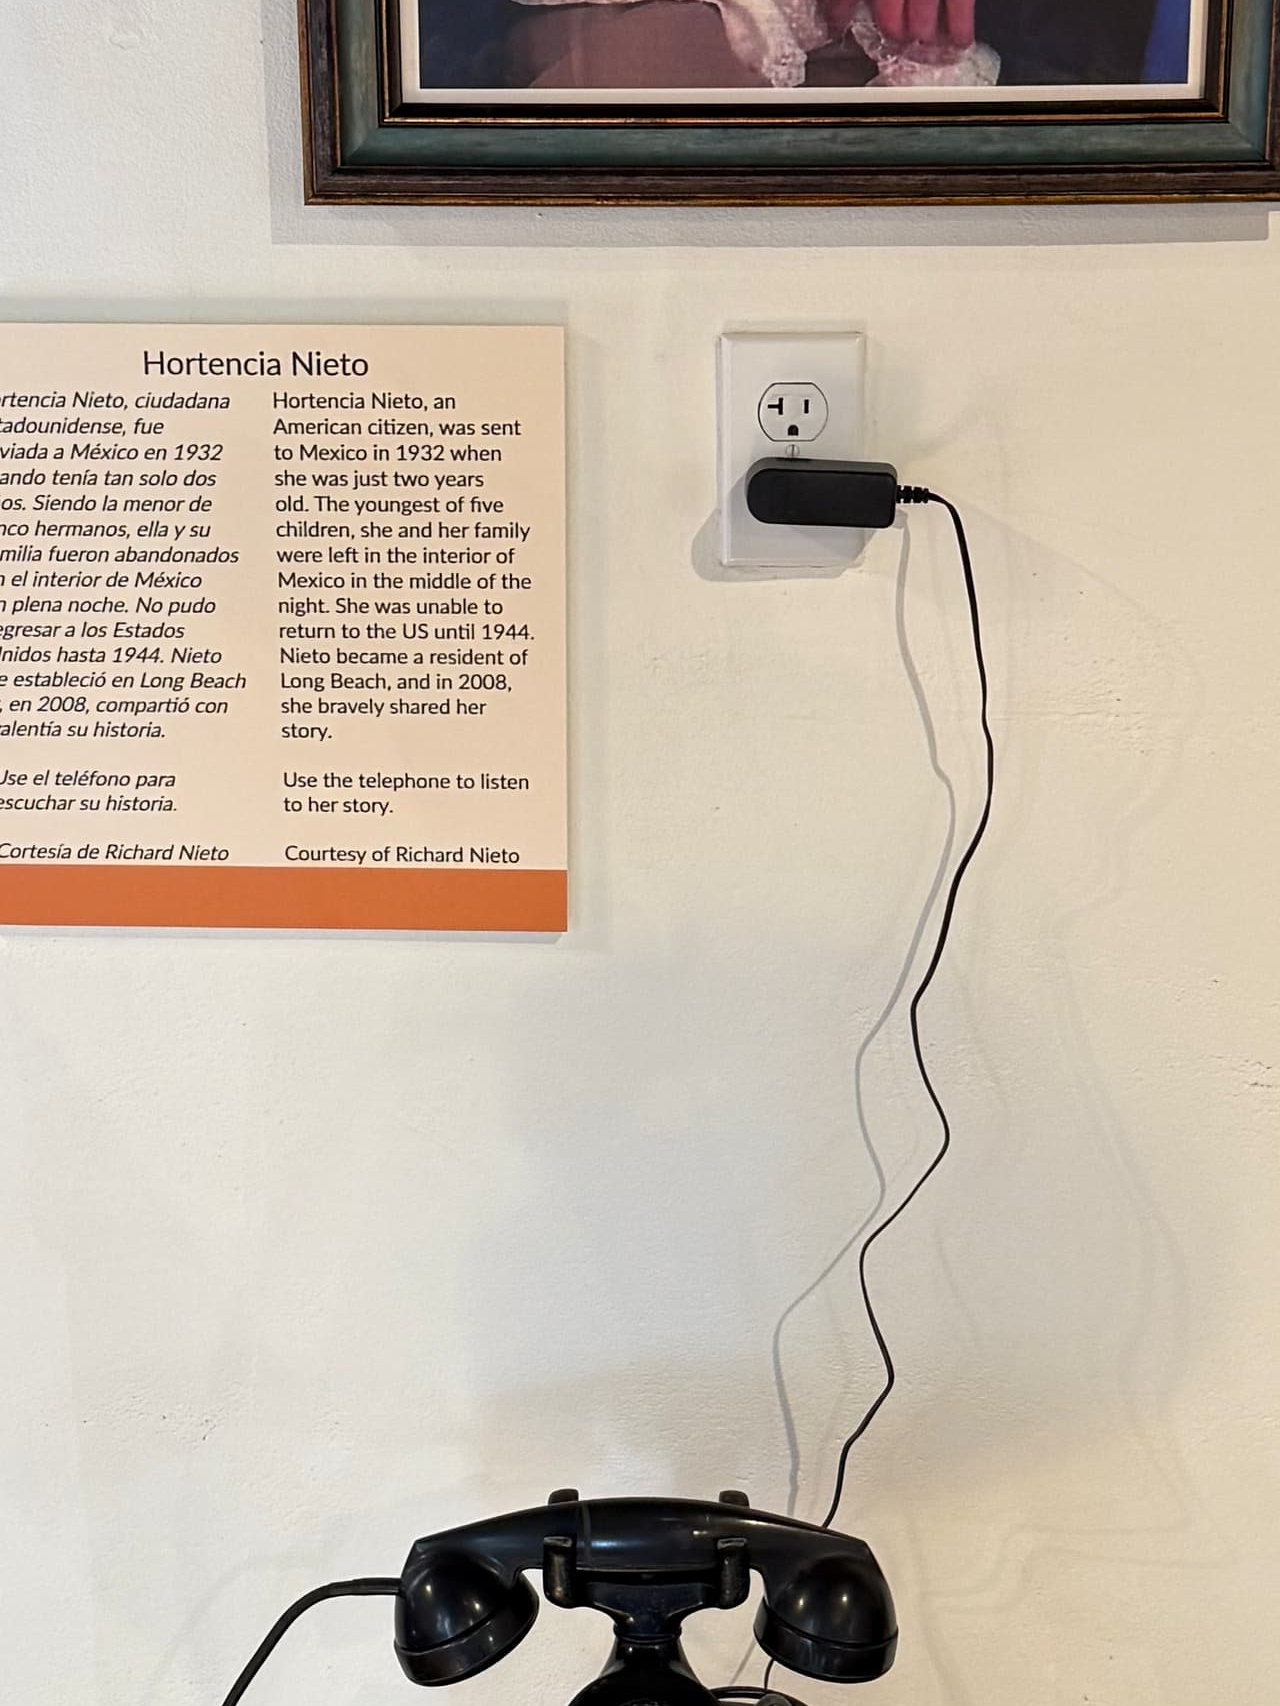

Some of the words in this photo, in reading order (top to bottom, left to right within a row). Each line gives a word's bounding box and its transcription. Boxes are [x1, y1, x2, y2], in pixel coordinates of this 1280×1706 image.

[143, 350, 282, 377] Hortencia
[291, 350, 369, 377] Nieto
[71, 390, 129, 412] Nieto,
[134, 391, 231, 410] ciudadana
[272, 391, 366, 410] Hortencia
[371, 391, 429, 413] Nieto,
[433, 396, 456, 410] an
[133, 417, 165, 435] fue
[272, 417, 363, 436] American
[367, 417, 434, 438] citizen,
[438, 422, 476, 436] was
[480, 419, 522, 436] sent
[52, 447, 65, 460] a
[69, 442, 140, 461] México
[143, 447, 168, 462] en
[173, 443, 224, 462] 1932
[273, 444, 294, 461] to
[299, 443, 368, 462] Mexico
[372, 443, 390, 462] in
[396, 444, 446, 462] 1932
[449, 443, 502, 462] when
[12, 670, 107, 688] estableció
[111, 675, 135, 689] en
[139, 671, 186, 693] Long
[189, 671, 247, 689] Beach
[280, 672, 326, 693] Long
[330, 671, 392, 692] Beach,
[396, 672, 431, 690] and
[435, 672, 453, 691] in
[457, 673, 512, 693] 2008,
[283, 771, 318, 789] Use
[322, 771, 354, 789] the
[358, 771, 451, 793] telephone
[455, 774, 476, 790] to
[480, 772, 530, 791] listen
[76, 843, 100, 860] de
[104, 843, 175, 861] Richard
[178, 844, 230, 861] Nieto
[284, 845, 368, 866] Courtesy
[370, 845, 391, 864] of
[396, 845, 464, 864] Richard
[469, 846, 521, 865] Nieto
